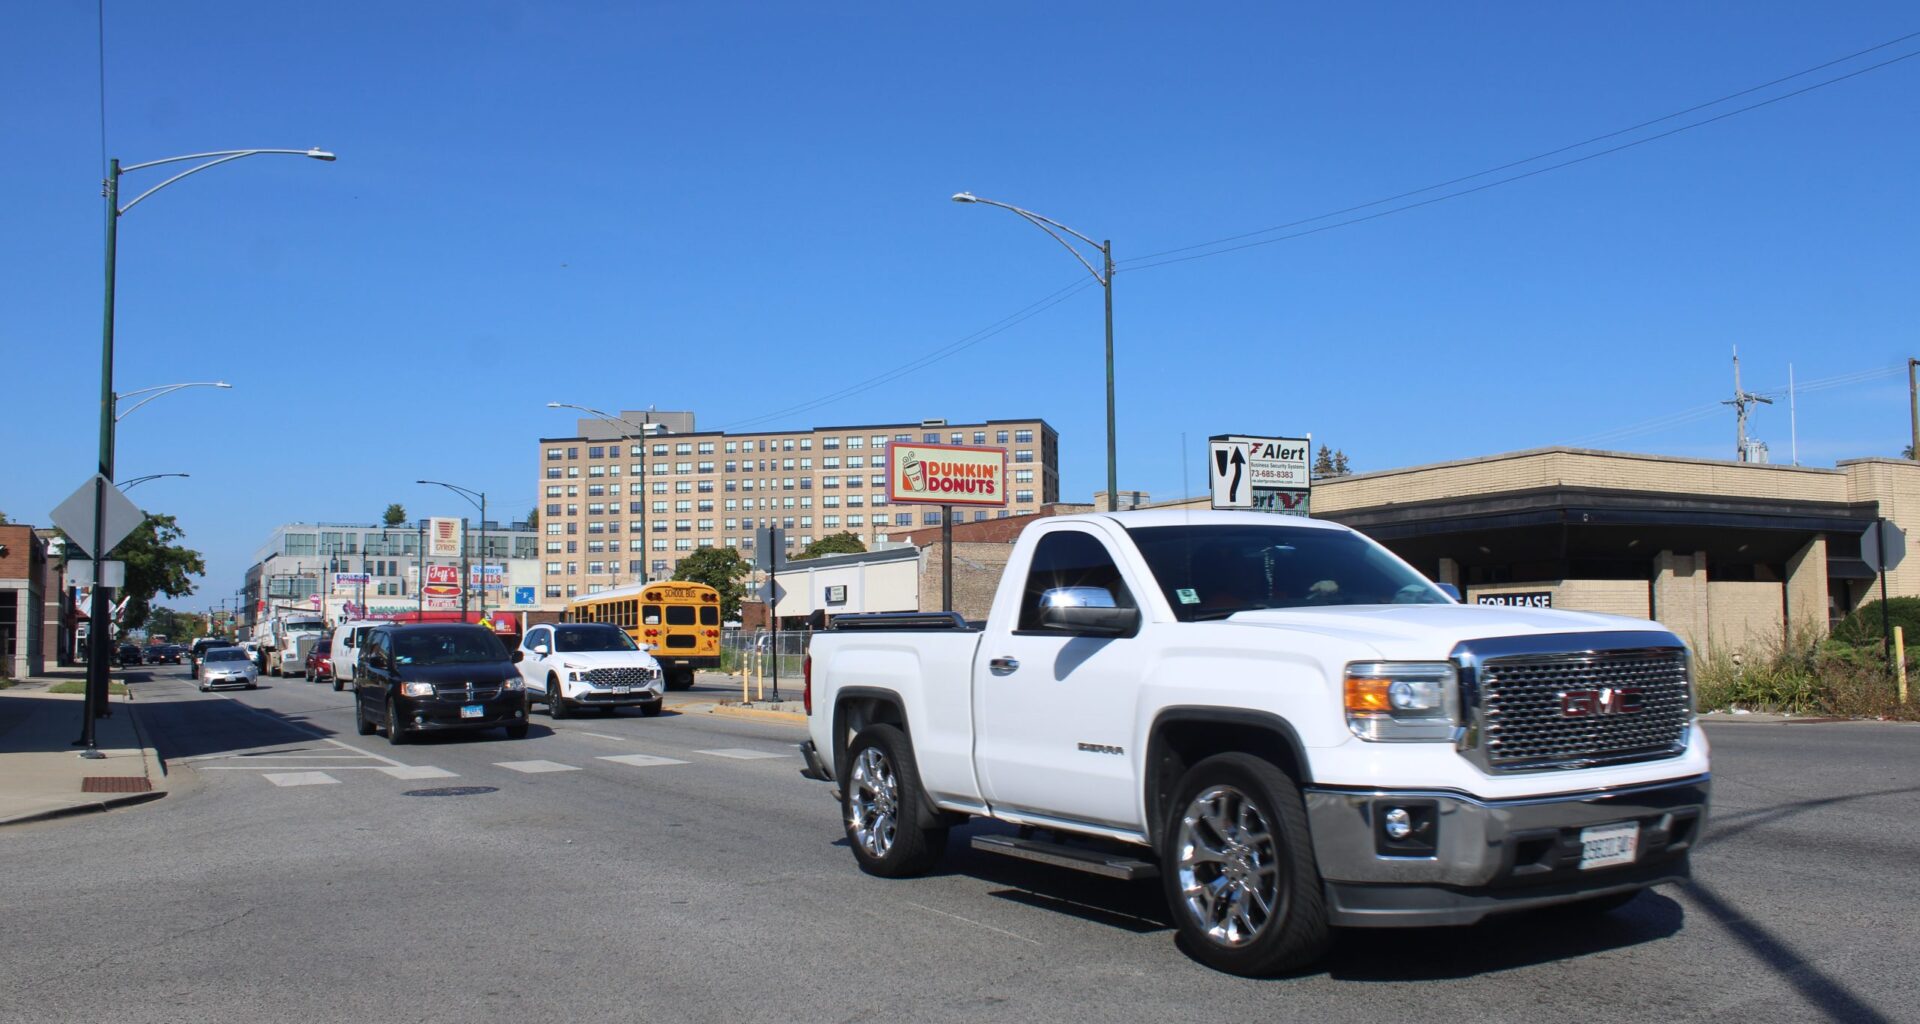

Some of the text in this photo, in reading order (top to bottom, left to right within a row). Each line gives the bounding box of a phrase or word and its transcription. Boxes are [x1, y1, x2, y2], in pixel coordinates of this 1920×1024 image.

[1263, 444, 1304, 460] Alert
[928, 461, 999, 478] DUNKIN'
[928, 477, 995, 494] DONUTS
[436, 543, 456, 551] GYROS
[430, 567, 456, 582] Jeff's
[665, 589, 696, 598] SCHOOL BUS
[1479, 596, 1549, 608] FOR LEASE
[1559, 687, 1642, 717] GMC
[1078, 743, 1124, 754] SIERRA
